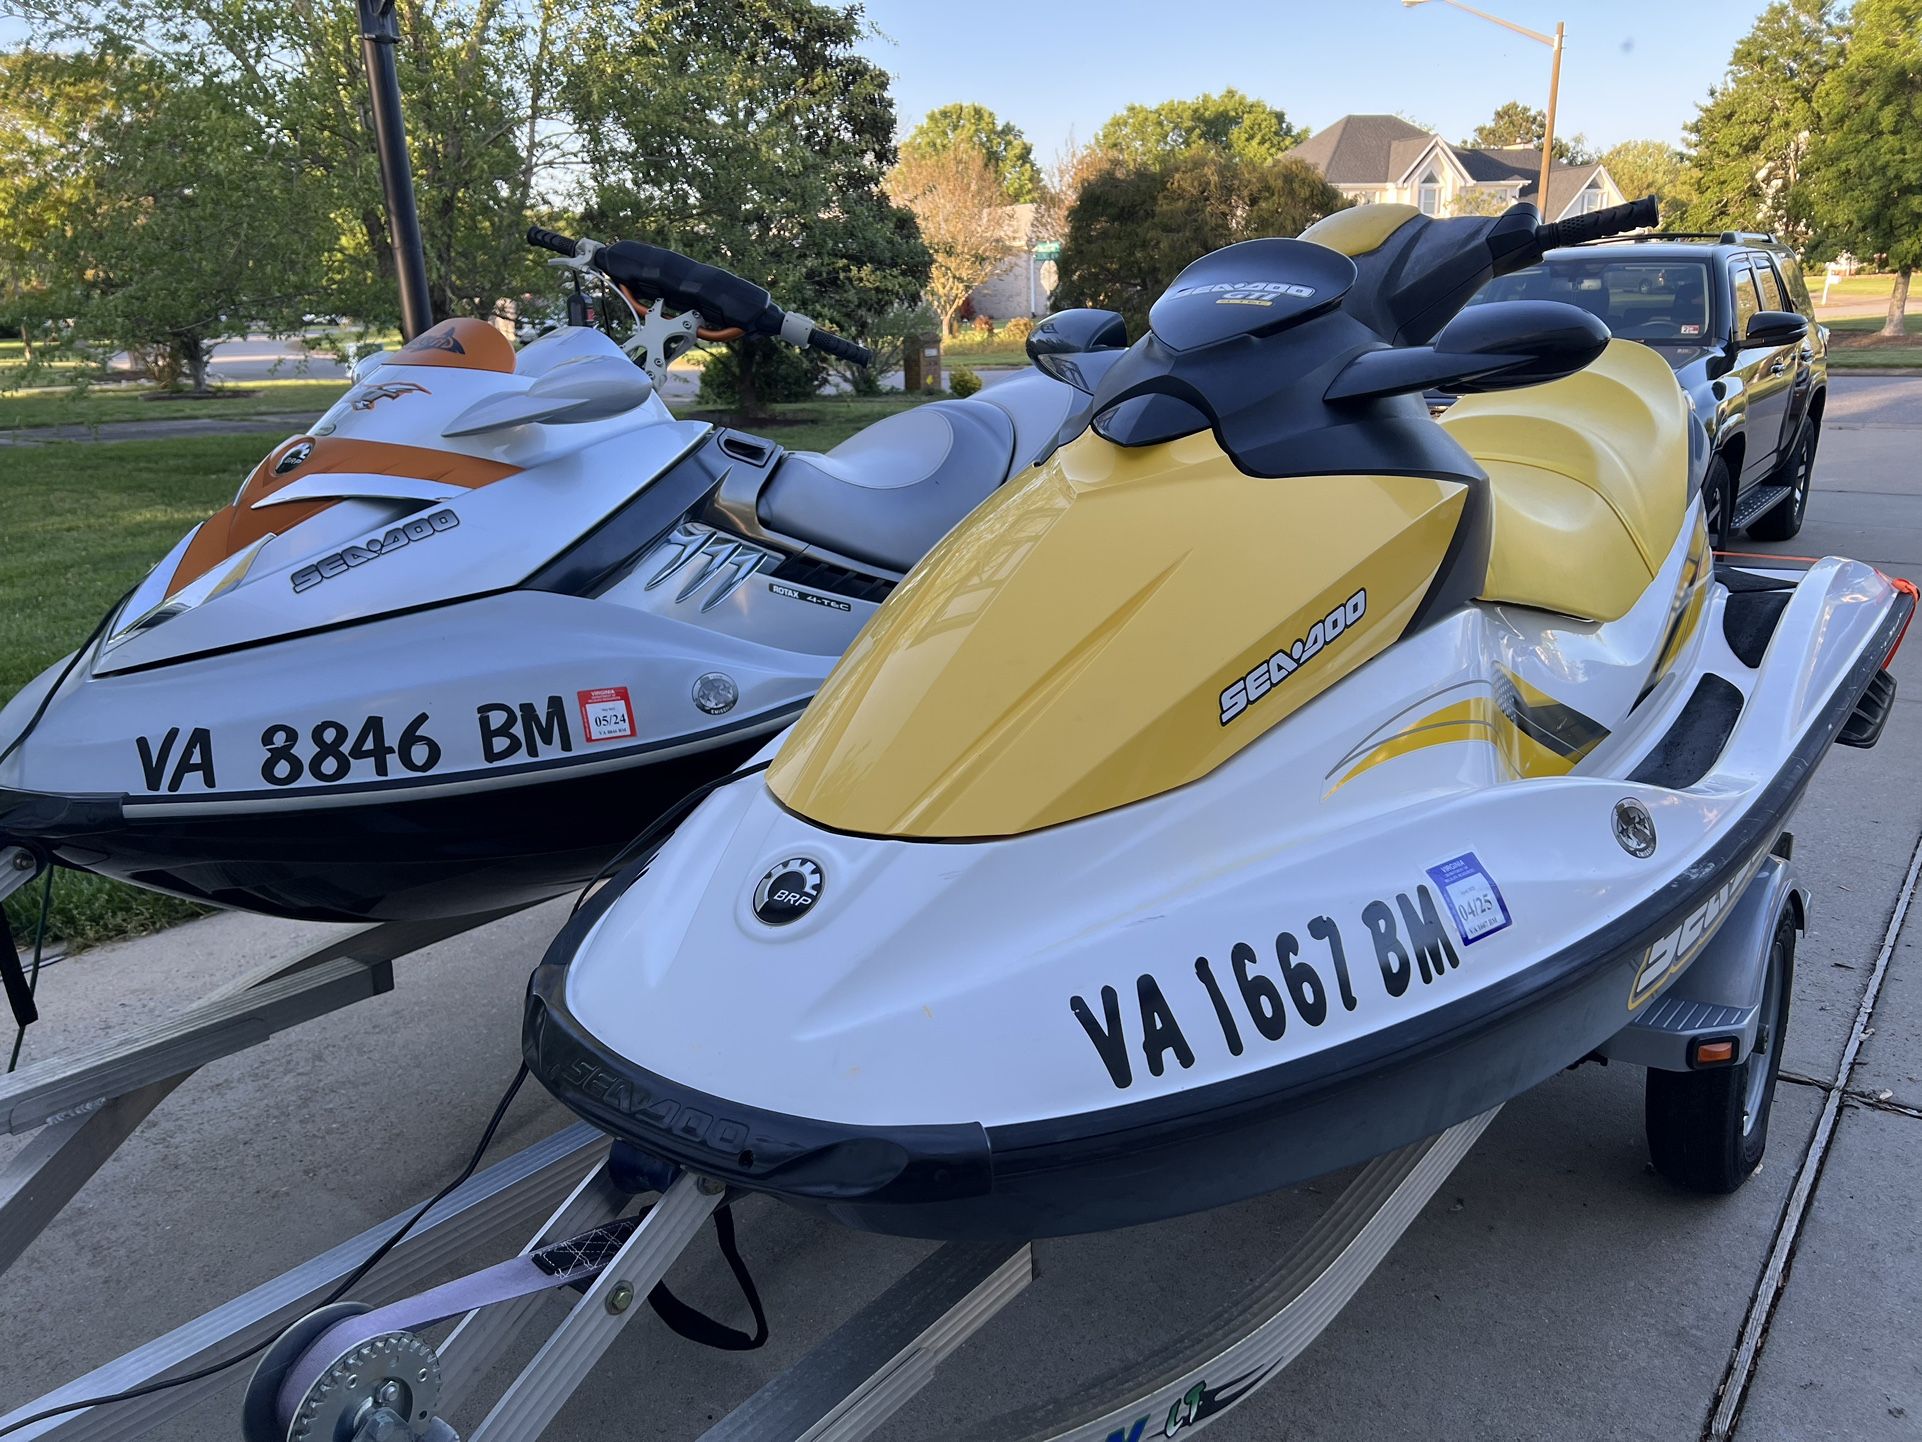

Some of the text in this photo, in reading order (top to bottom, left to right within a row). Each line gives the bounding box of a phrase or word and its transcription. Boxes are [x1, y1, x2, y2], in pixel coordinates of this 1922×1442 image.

[1222, 291, 1281, 301] GTI
[772, 585, 800, 599] ROTAX
[594, 713, 627, 727] 05/24
[136, 726, 216, 792] VA
[260, 712, 441, 785] 8846
[477, 695, 573, 764] BM
[773, 889, 812, 906] BRP
[1458, 893, 1493, 922] 04/25
[1070, 884, 1460, 1089] VA 1667 BM
